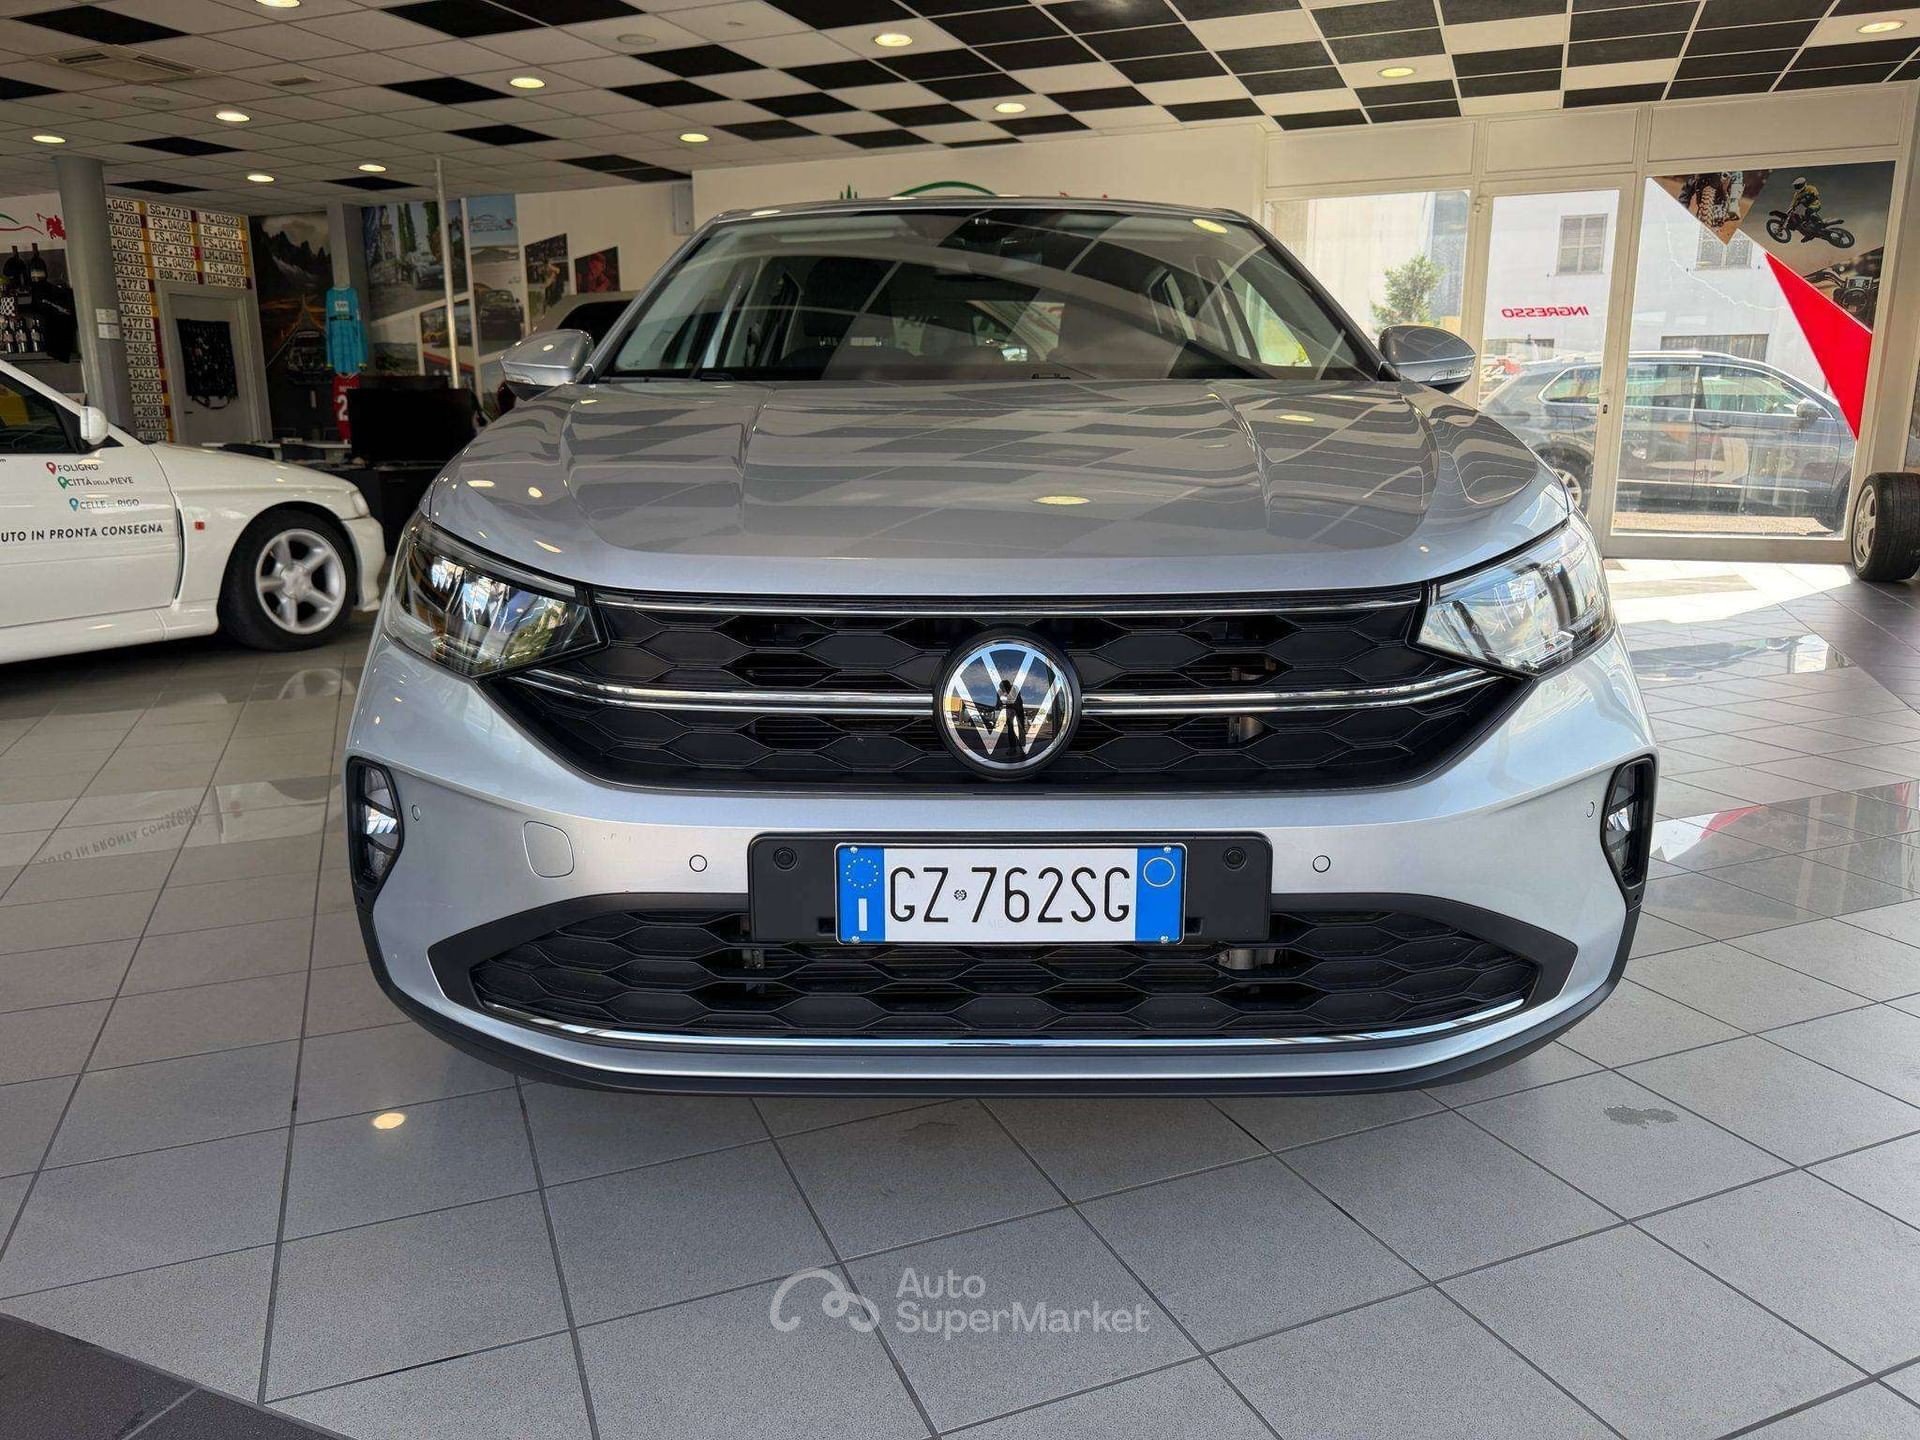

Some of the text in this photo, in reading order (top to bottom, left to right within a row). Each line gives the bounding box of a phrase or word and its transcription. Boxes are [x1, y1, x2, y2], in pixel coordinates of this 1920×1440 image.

[57, 463, 99, 473] FOLIGNO
[109, 476, 134, 485] PIEVE
[80, 500, 107, 510] CELLE
[117, 499, 140, 508] RIGO
[31, 530, 45, 541] IN
[50, 527, 98, 539] PRONTA
[101, 523, 164, 537] CONSEGNA
